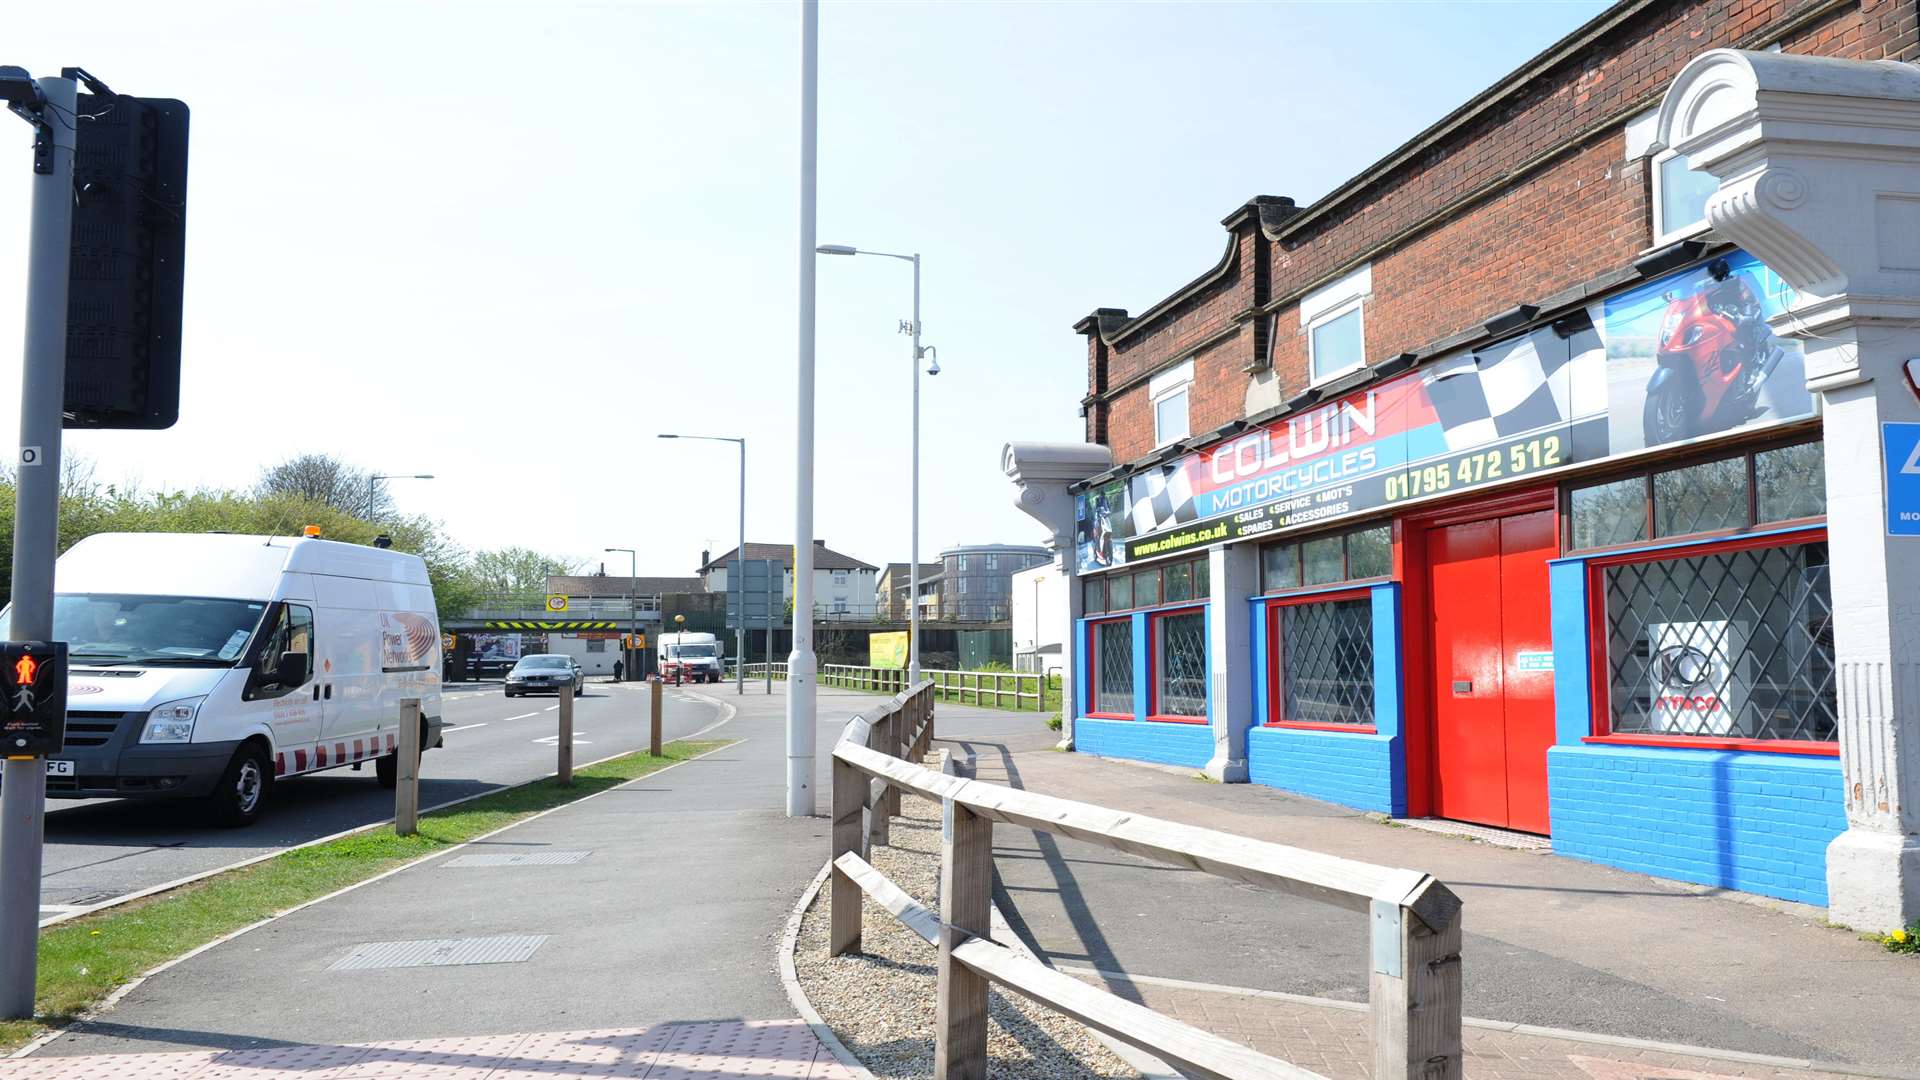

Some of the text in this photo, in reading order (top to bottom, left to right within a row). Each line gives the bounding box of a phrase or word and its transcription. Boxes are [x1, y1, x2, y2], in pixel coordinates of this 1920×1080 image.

[1211, 390, 1376, 484] COLWIN
[1212, 446, 1377, 511] MOTORCYCLES
[1385, 436, 1561, 501] 01795 472 512
[1238, 486, 1353, 524] SALES SERVICE MOT'S
[1242, 502, 1349, 537] SPARES ACCESSORIES
[1133, 522, 1228, 557] www.colwins.co.uk
[47, 762, 67, 773] FG
